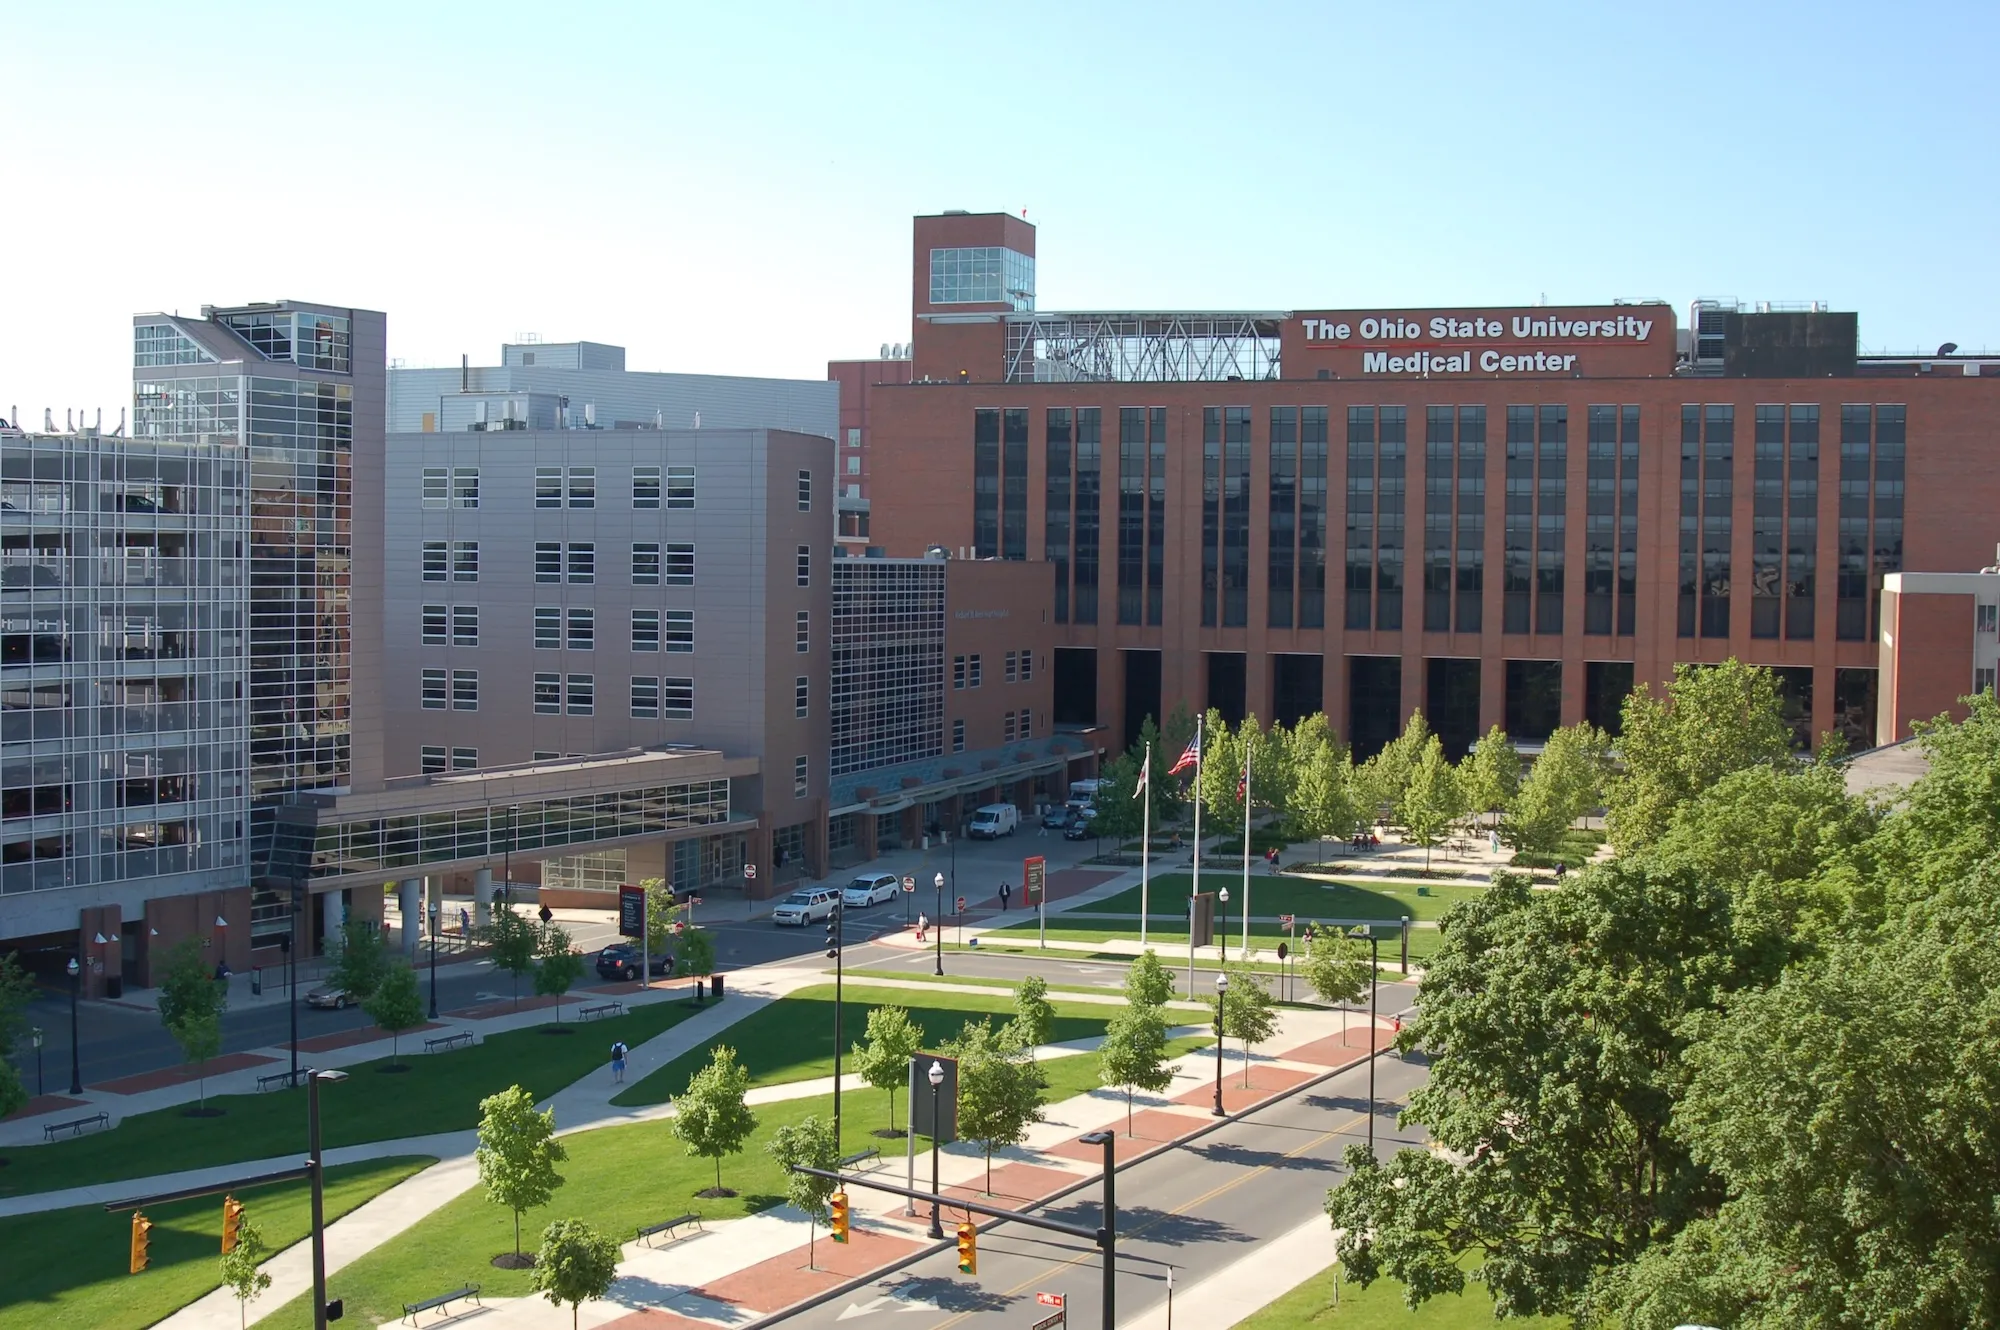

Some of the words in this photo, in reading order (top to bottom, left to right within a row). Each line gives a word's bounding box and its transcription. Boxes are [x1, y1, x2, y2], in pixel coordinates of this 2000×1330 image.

[1302, 319, 1350, 340] The
[1359, 318, 1421, 339] Ohio
[1429, 317, 1503, 339] State
[1512, 315, 1652, 340] University
[1363, 351, 1471, 373] Medical
[1479, 350, 1577, 372] Center
